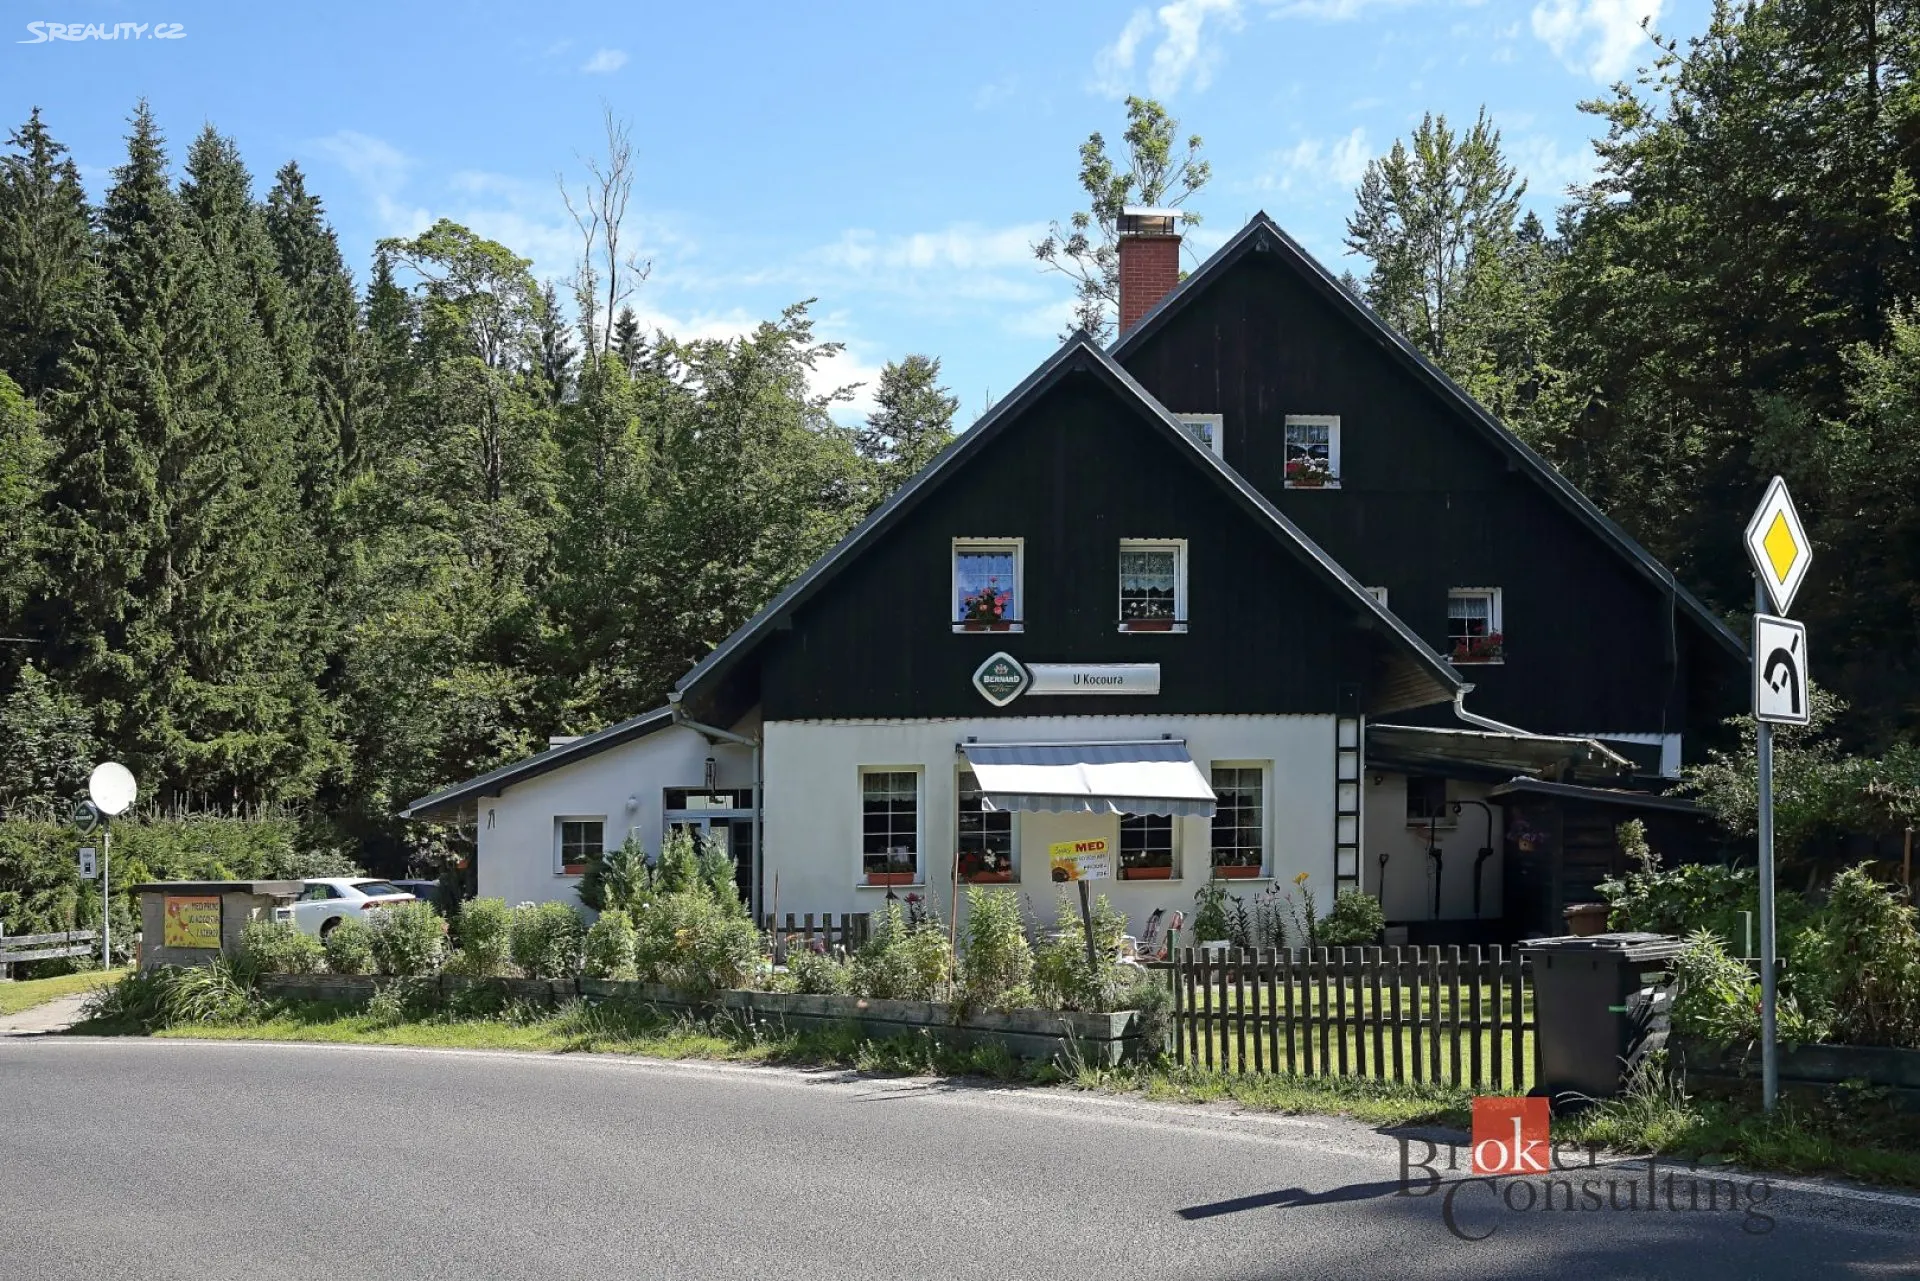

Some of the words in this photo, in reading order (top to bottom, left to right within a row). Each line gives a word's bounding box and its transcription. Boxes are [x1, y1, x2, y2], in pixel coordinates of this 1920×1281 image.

[983, 673, 1020, 683] BERNARD
[1073, 673, 1080, 685] U
[1083, 673, 1124, 685] Kocoura
[1075, 841, 1105, 852] MED
